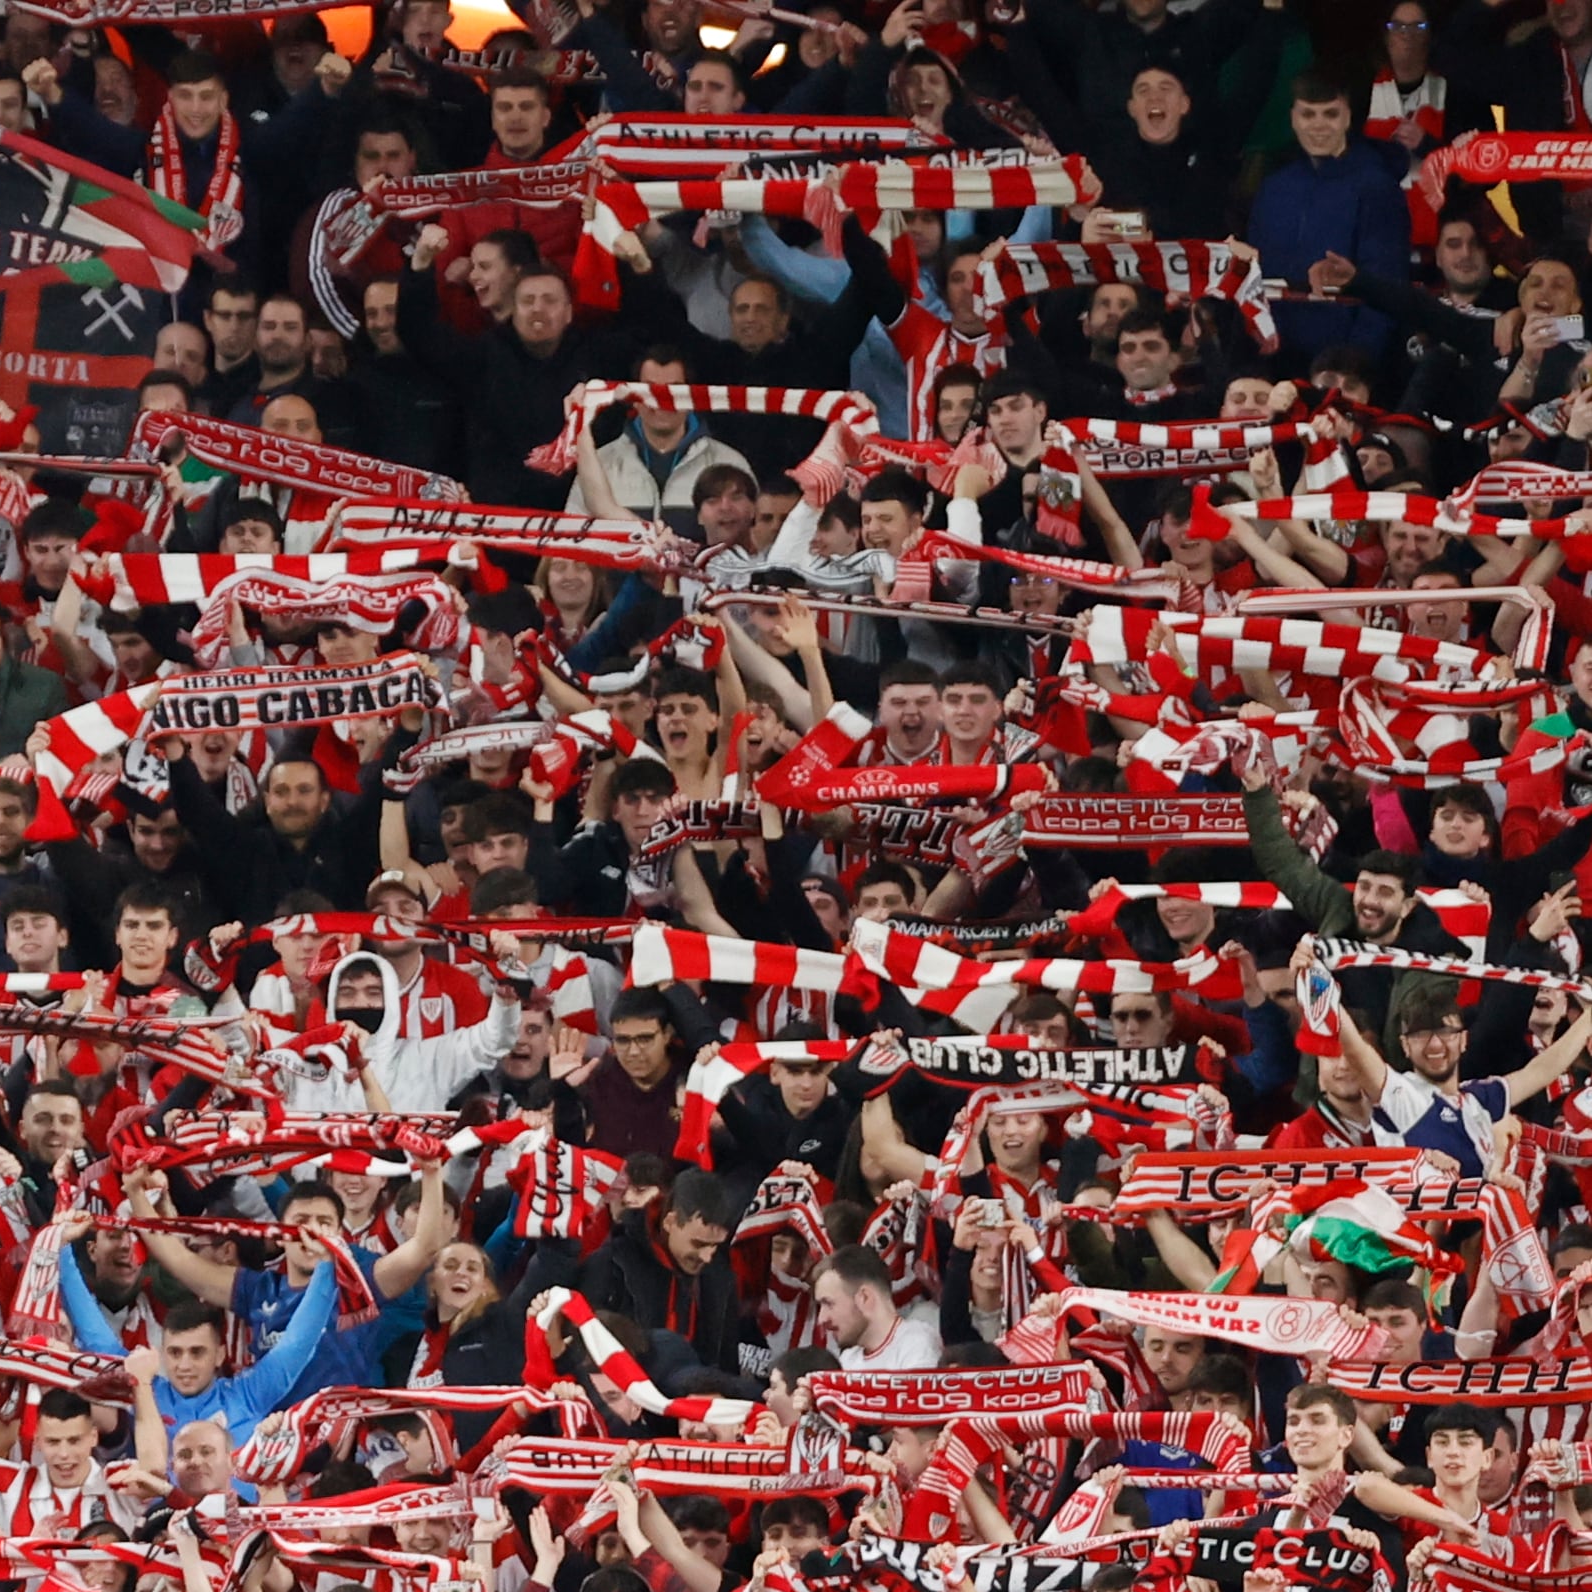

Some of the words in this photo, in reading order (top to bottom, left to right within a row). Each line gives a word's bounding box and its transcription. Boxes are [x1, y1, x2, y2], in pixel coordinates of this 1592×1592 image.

[619, 122, 773, 150] ATHLETIC
[383, 169, 503, 190] ATHLETIC
[518, 163, 587, 181] CLUB
[10, 230, 96, 266] TEAM
[317, 464, 389, 495] kopa
[388, 504, 510, 544] Athletic
[181, 668, 258, 692] HERRI
[266, 659, 396, 685] HARMAILA
[816, 782, 940, 802] CHAMPIONS
[1042, 797, 1182, 815] ATHLETIC
[1045, 816, 1121, 831] copa
[1129, 815, 1189, 831] f-09
[905, 1040, 1008, 1077] CLUB
[1017, 1043, 1187, 1082] ATHLETIC
[971, 1367, 1060, 1388] CLUB
[1365, 1357, 1576, 1396] ICHH
[895, 1389, 970, 1410] f-09
[979, 1391, 1060, 1411] kopa
[645, 1443, 786, 1477] ATHLETIC
[1271, 1536, 1372, 1576] CLUB
